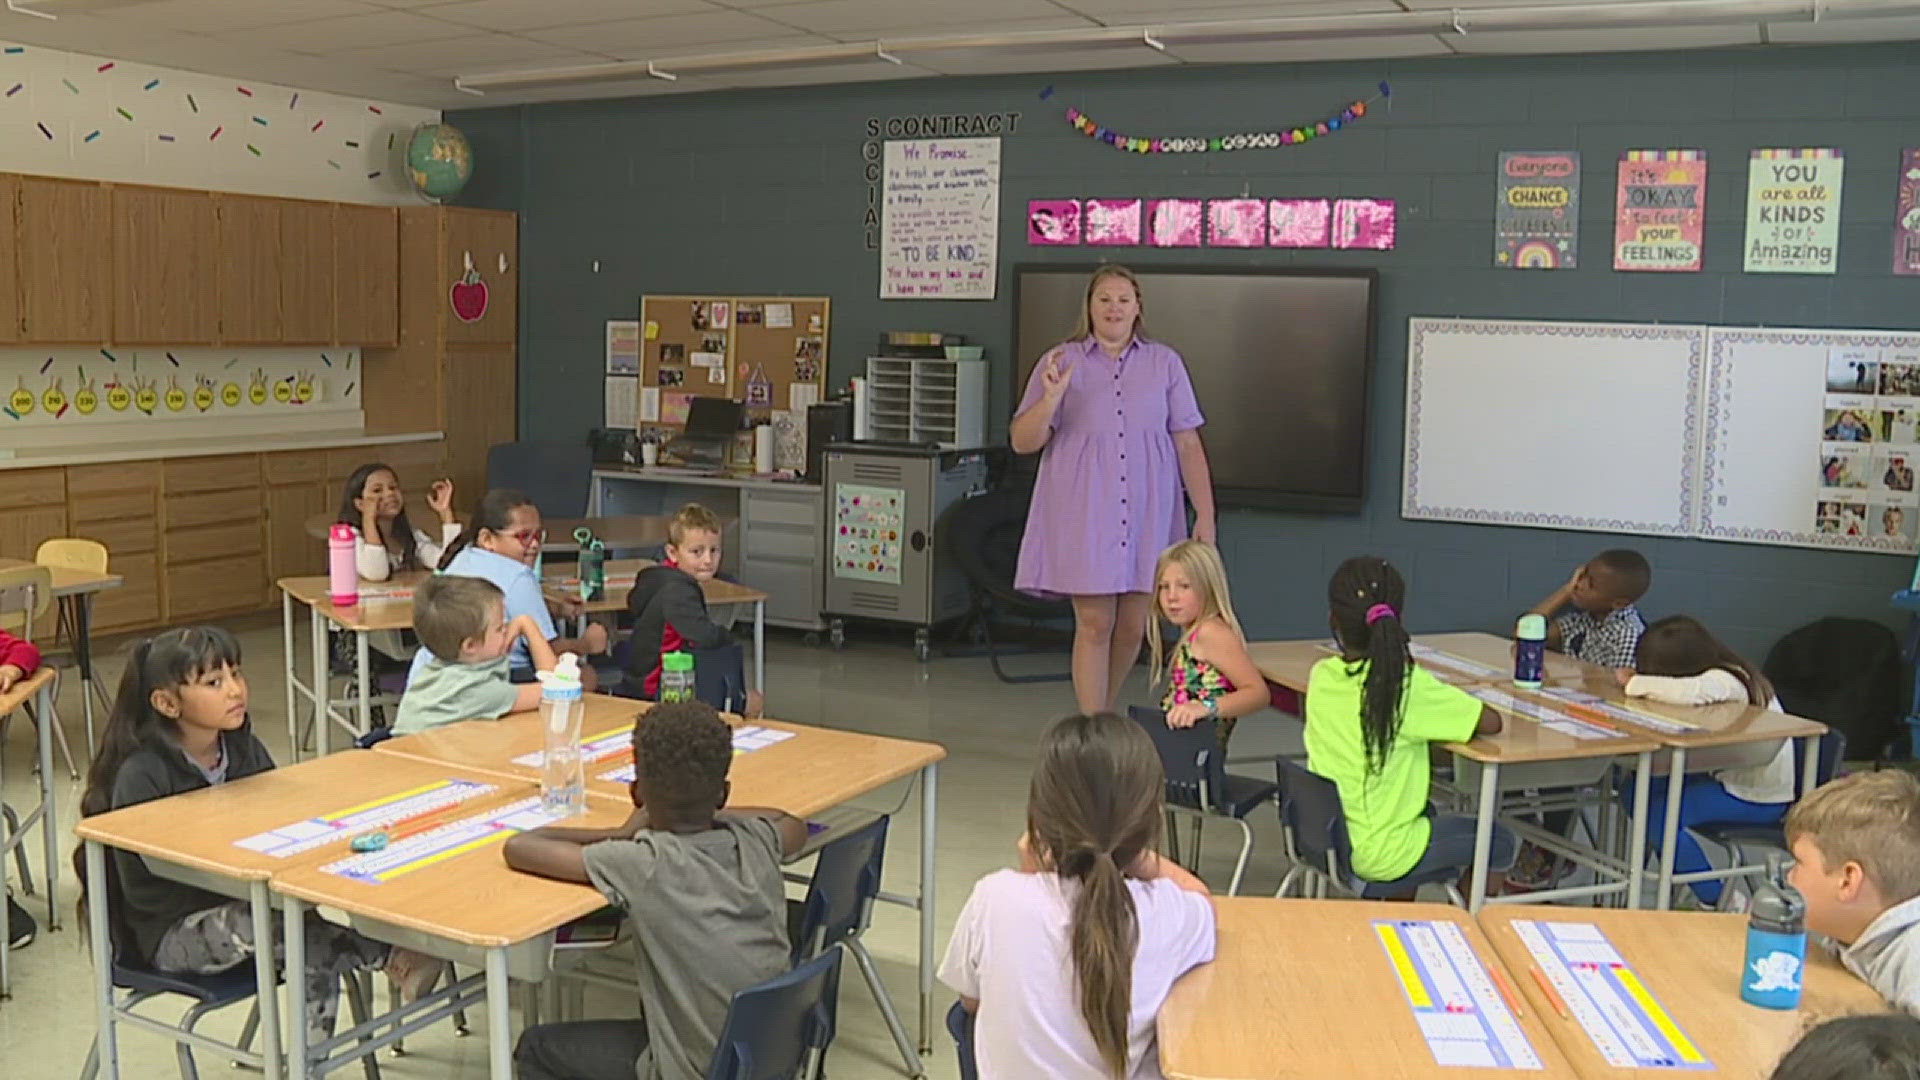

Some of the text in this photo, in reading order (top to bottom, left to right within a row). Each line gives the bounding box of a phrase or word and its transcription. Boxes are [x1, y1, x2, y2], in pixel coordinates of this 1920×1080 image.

[888, 113, 1021, 134] CONTRACT
[903, 143, 919, 159] We
[1509, 160, 1569, 175] Everyone
[1772, 165, 1817, 182] YOU
[865, 118, 880, 249] SOCIAL
[1512, 191, 1562, 203] CHANCE
[1631, 189, 1691, 206] OKAY
[1762, 185, 1826, 200] are all
[1760, 206, 1826, 223] KINDS
[1640, 229, 1678, 242] your
[901, 244, 975, 262] TO BE KIND
[1622, 246, 1694, 260] FEELINGS
[1750, 239, 1832, 265] Amazing
